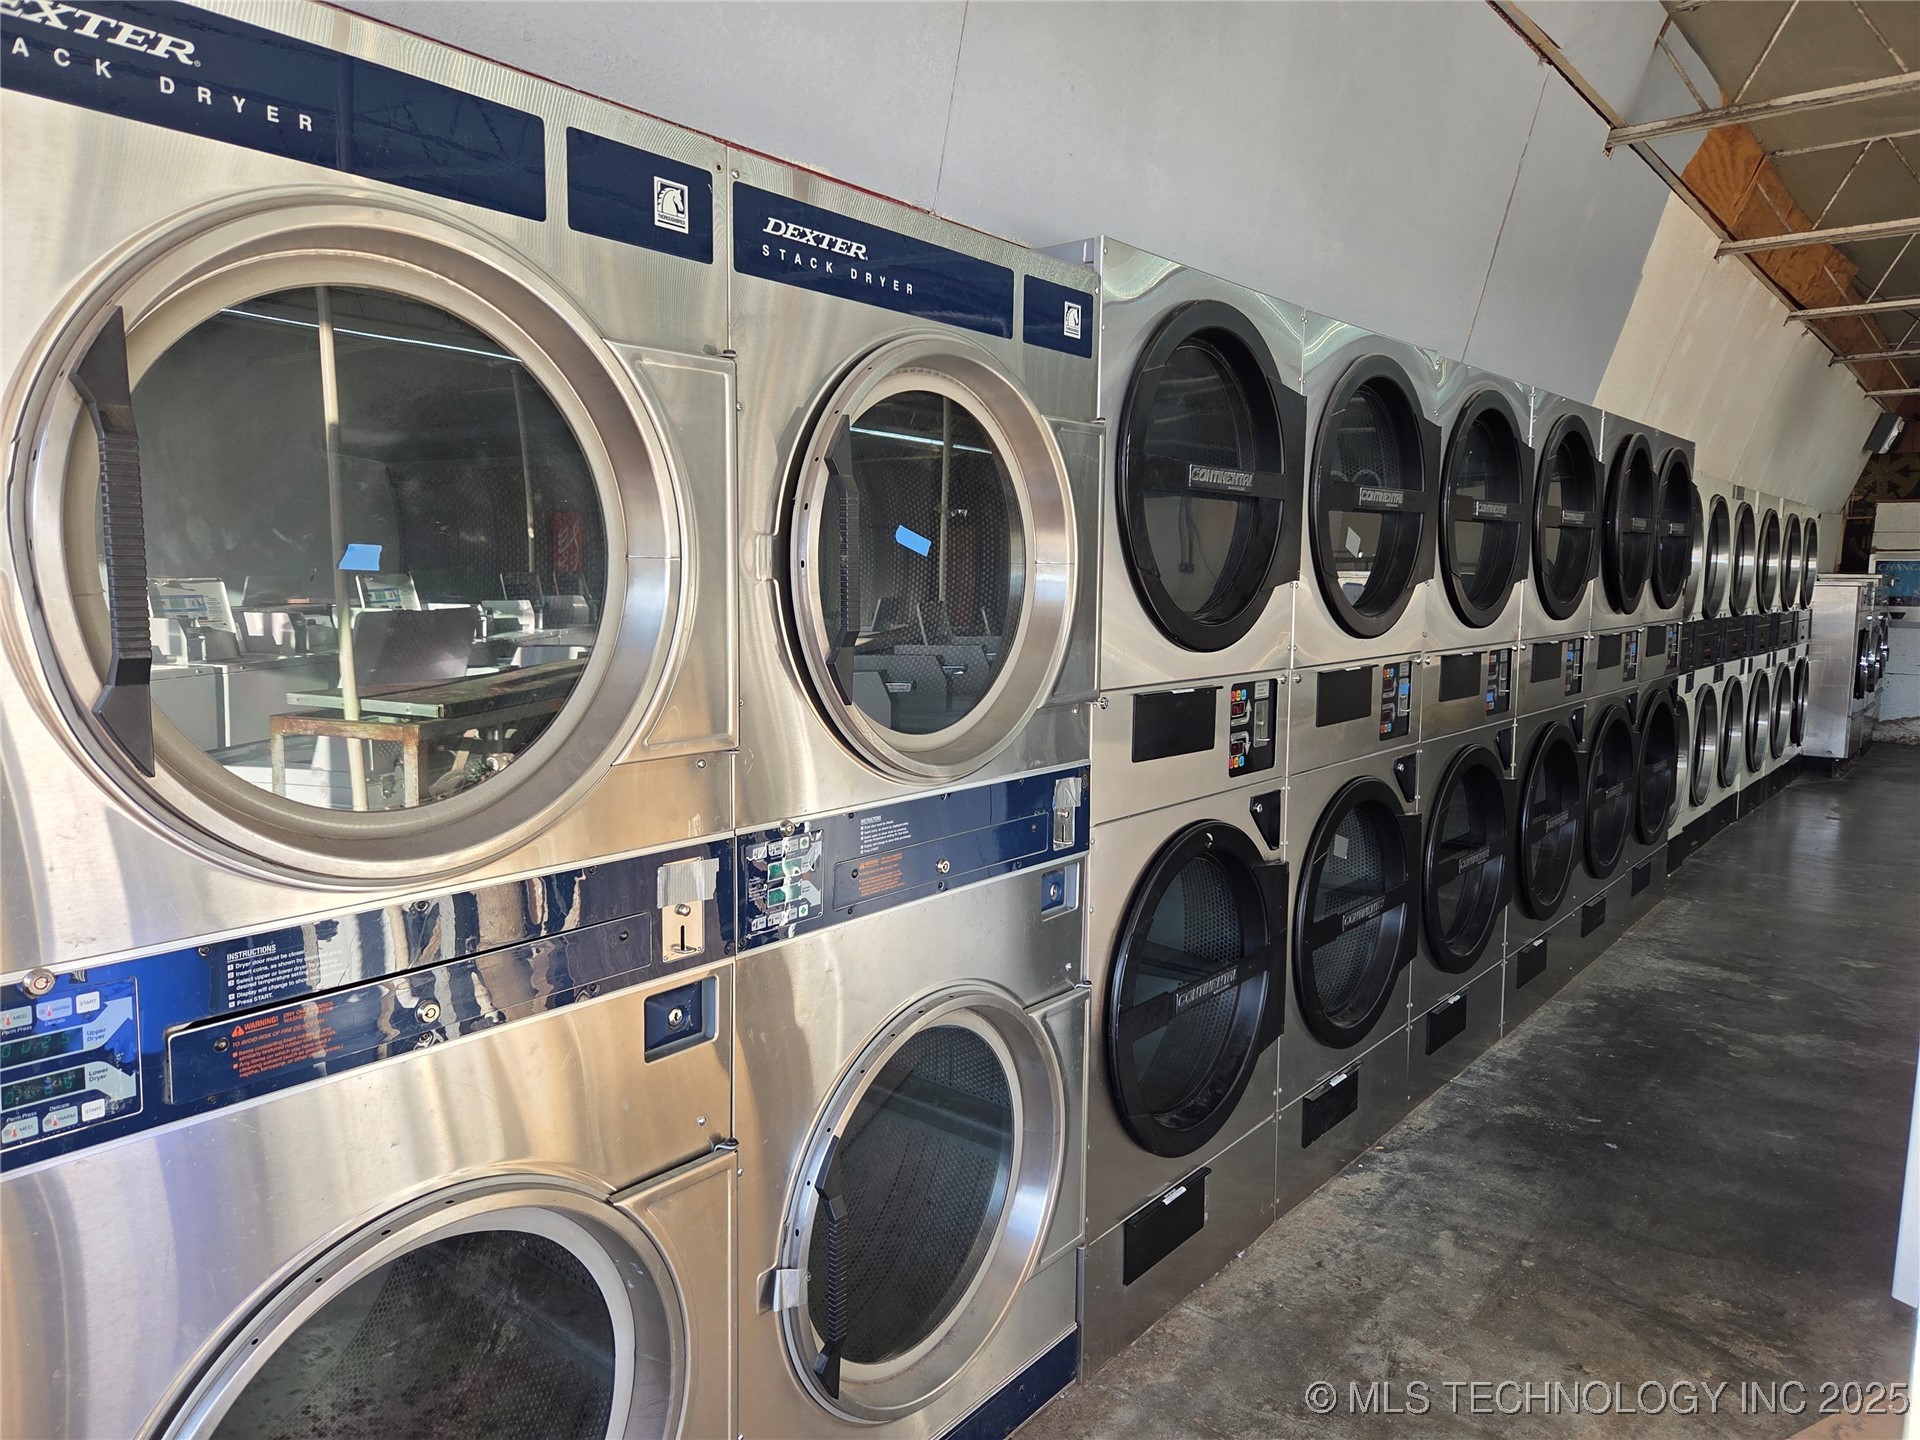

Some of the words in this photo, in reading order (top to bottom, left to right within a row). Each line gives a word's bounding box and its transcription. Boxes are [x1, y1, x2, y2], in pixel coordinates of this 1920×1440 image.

[160, 76, 312, 132] DRYER
[762, 217, 867, 260] DEXTER
[762, 244, 833, 274] STACK
[851, 267, 914, 295] DRYER
[1192, 467, 1253, 487] CONTINENTAL
[1878, 563, 1920, 572] CHANG
[227, 944, 276, 959] INSTRUCTIONS
[237, 989, 257, 998] Display
[244, 1016, 278, 1029] WARNING!
[87, 1028, 106, 1036] Upper
[87, 1034, 105, 1042] Dryer
[89, 1067, 109, 1076] Lower
[89, 1074, 107, 1082] Dryer
